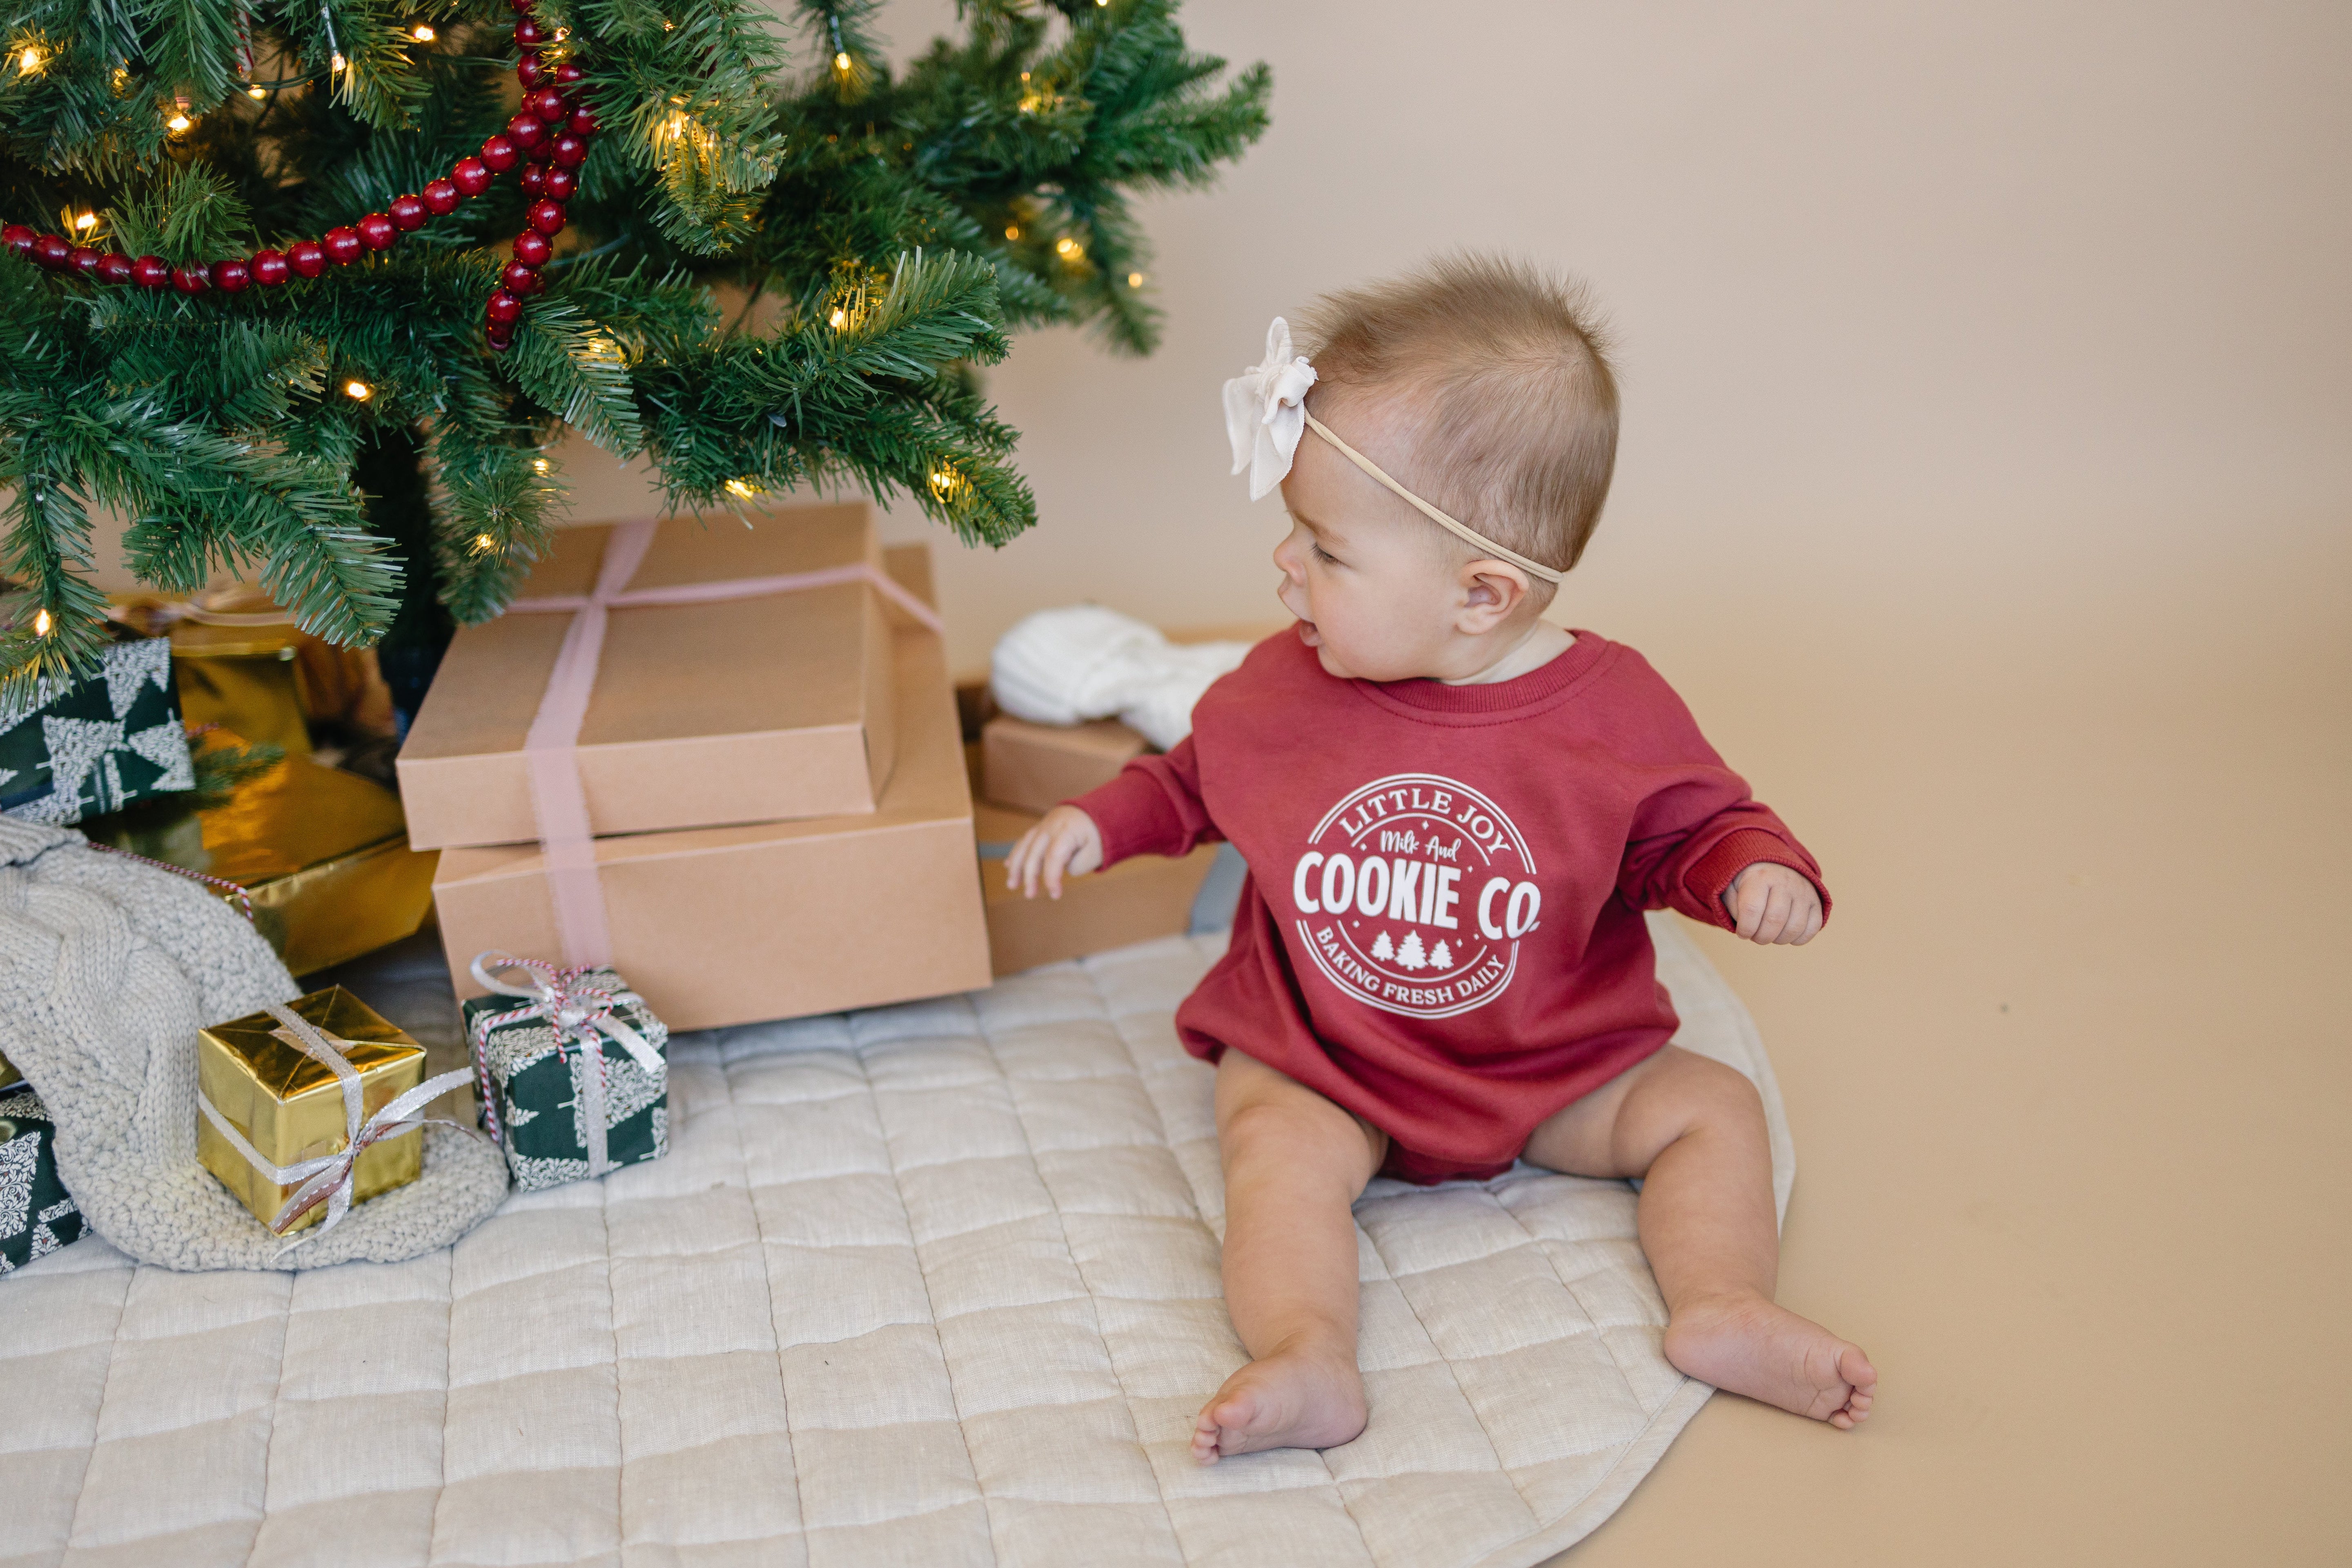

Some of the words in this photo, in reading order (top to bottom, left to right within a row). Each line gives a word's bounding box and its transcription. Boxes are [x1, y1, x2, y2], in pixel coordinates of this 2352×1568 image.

[1339, 788, 1452, 837] LITTLE
[1456, 805, 1512, 854] JOY
[1380, 829, 1419, 854] Milk
[1425, 835, 1461, 862] And
[1293, 851, 1461, 930] COOKIE
[1316, 926, 1380, 991] BAKING
[1383, 982, 1454, 1005] FRESH
[1456, 955, 1505, 997] DAILY
